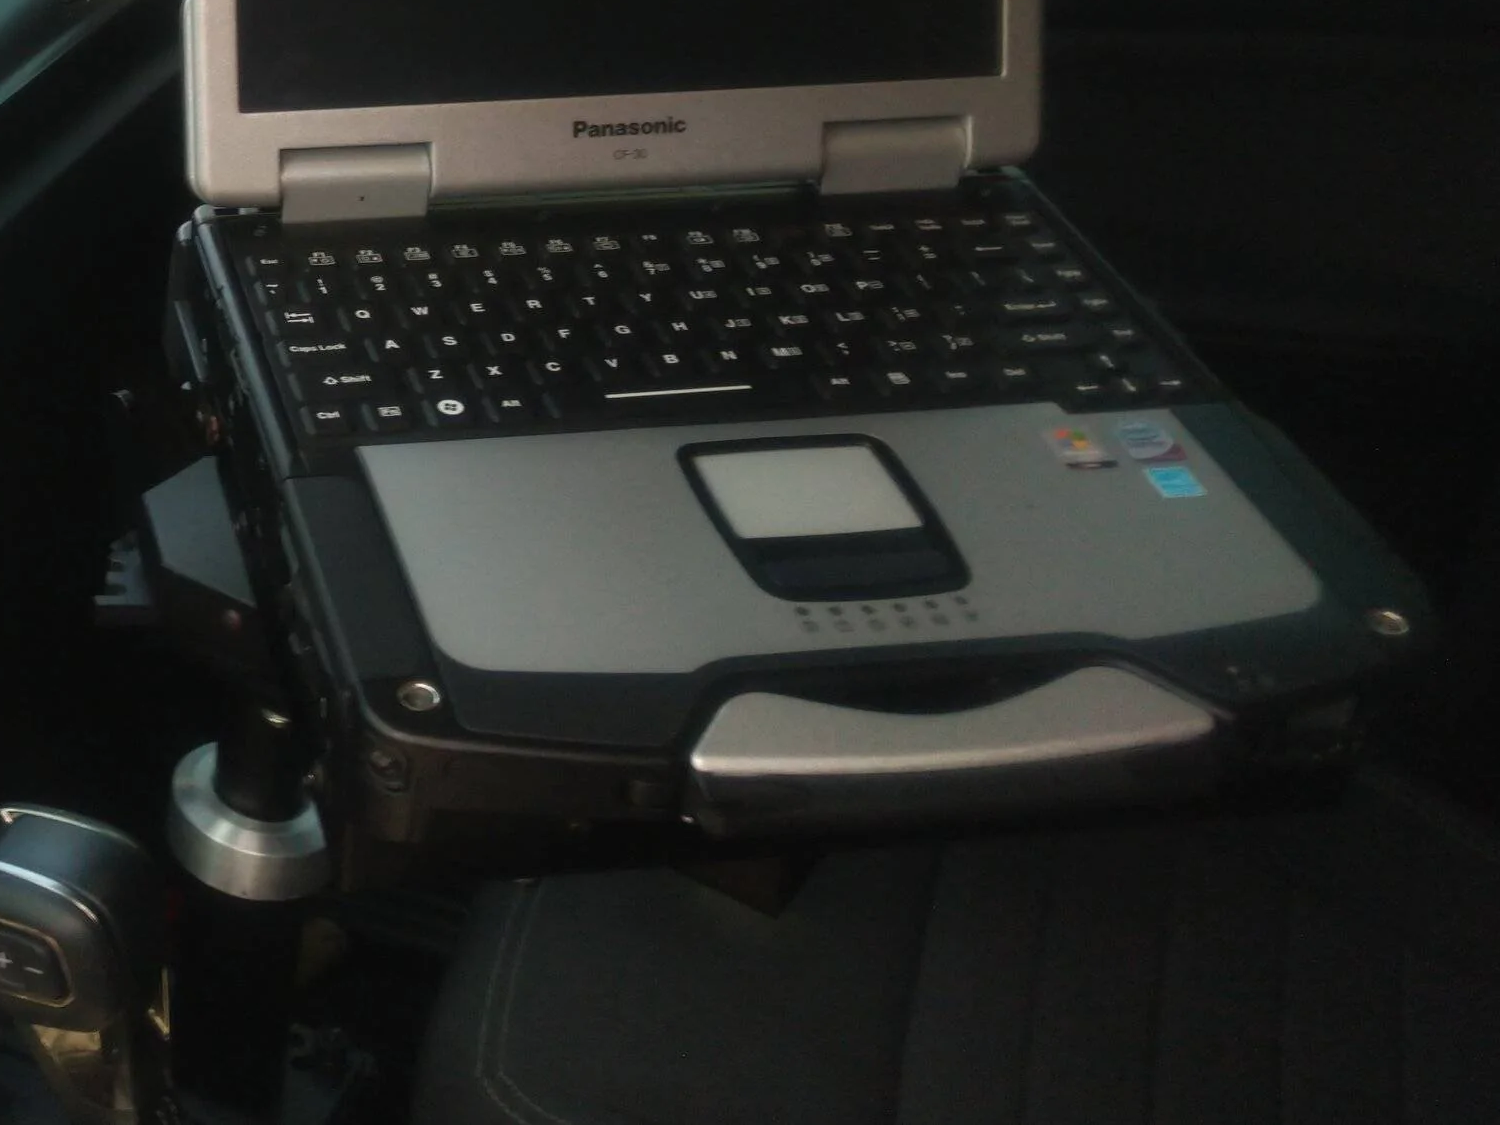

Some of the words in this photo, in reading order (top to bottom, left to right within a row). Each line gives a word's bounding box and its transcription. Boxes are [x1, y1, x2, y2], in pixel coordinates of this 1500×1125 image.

[573, 116, 687, 139] Panasonic
[800, 284, 816, 293] O
[639, 293, 652, 302] Y
[689, 290, 705, 300] U
[525, 299, 542, 309] R
[582, 296, 595, 306] T
[410, 306, 429, 316] W
[469, 303, 486, 313] E
[355, 309, 371, 319] Q
[835, 312, 851, 322] L
[778, 315, 796, 325] K
[614, 325, 631, 335] G
[671, 321, 689, 331] H
[500, 333, 516, 342] D
[558, 328, 570, 339] F
[385, 339, 400, 349] A
[441, 336, 458, 346] S
[662, 354, 679, 364] B
[720, 350, 738, 360] N
[545, 361, 561, 372] C
[604, 358, 618, 368] V
[428, 369, 444, 380] Z
[486, 365, 503, 376] X
